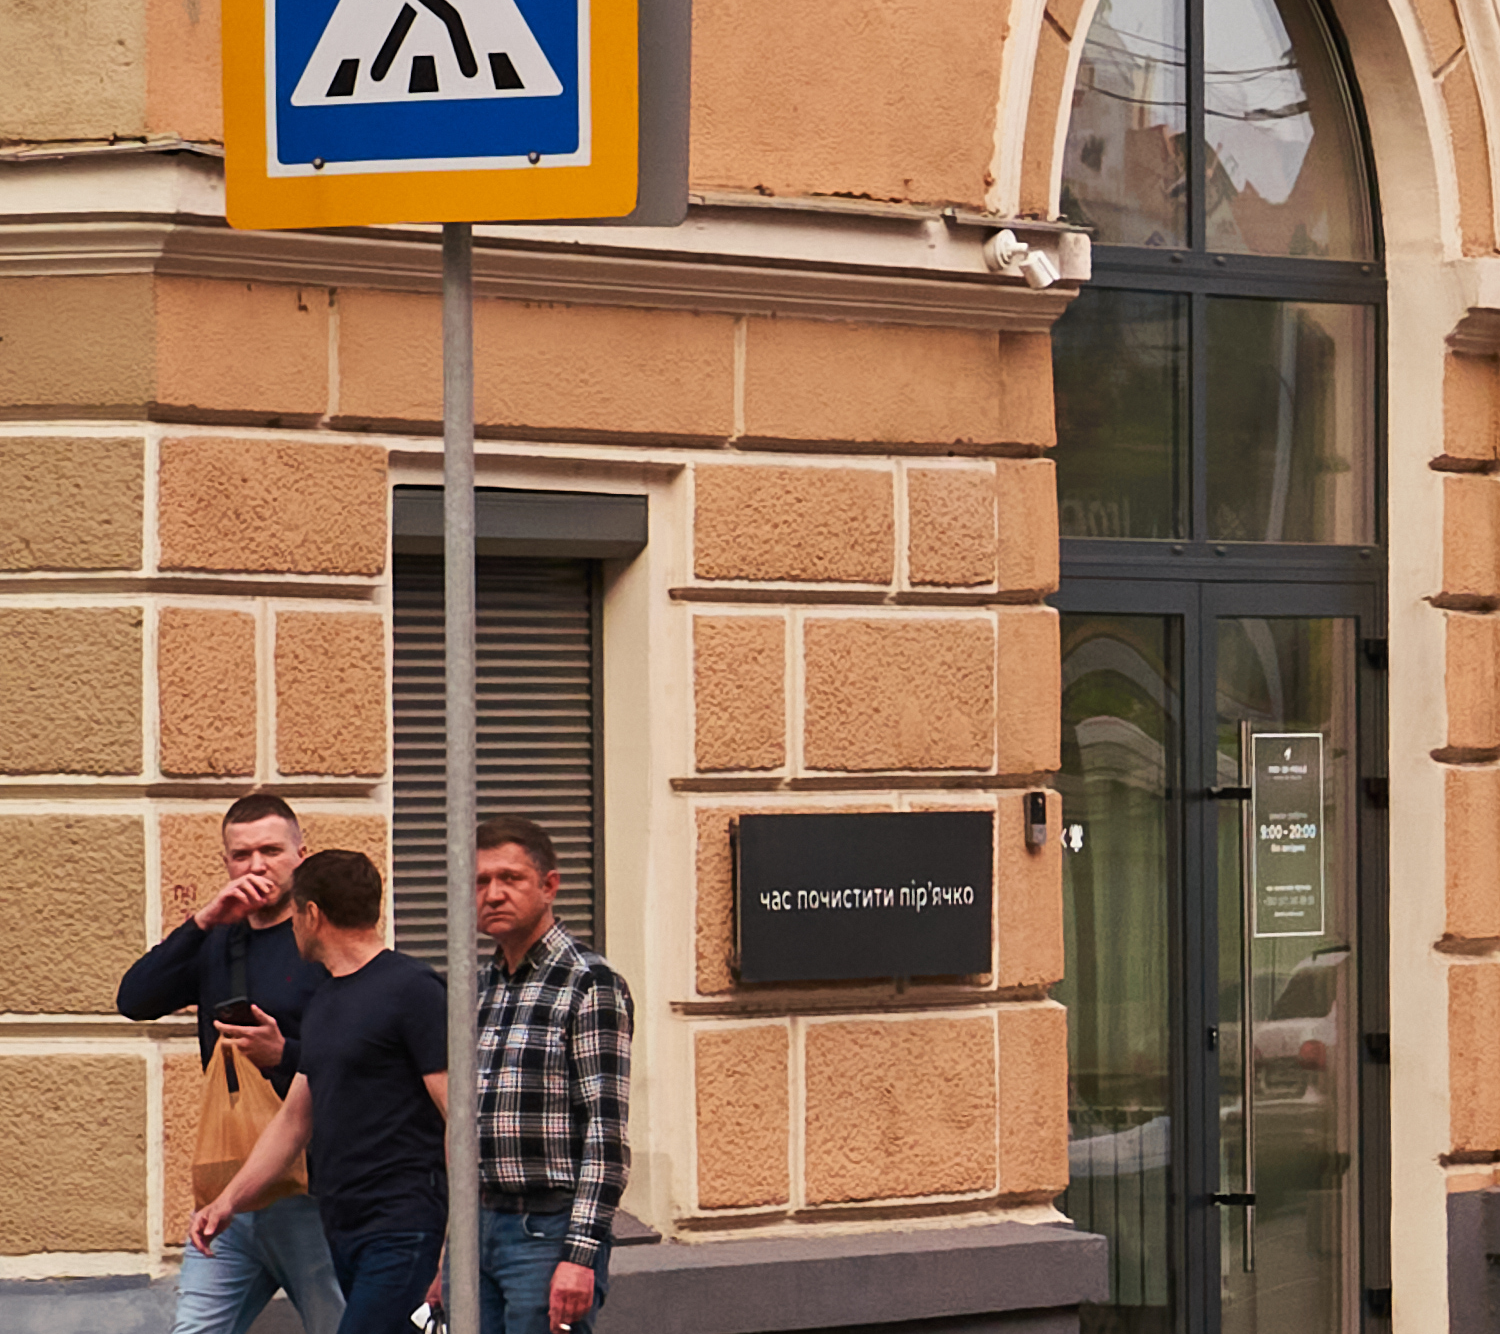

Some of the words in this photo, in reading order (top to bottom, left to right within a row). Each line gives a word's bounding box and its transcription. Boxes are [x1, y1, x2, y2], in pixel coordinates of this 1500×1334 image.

[760, 889, 792, 911] час
[797, 887, 895, 911] почистити
[899, 878, 975, 913] пір'ячко
